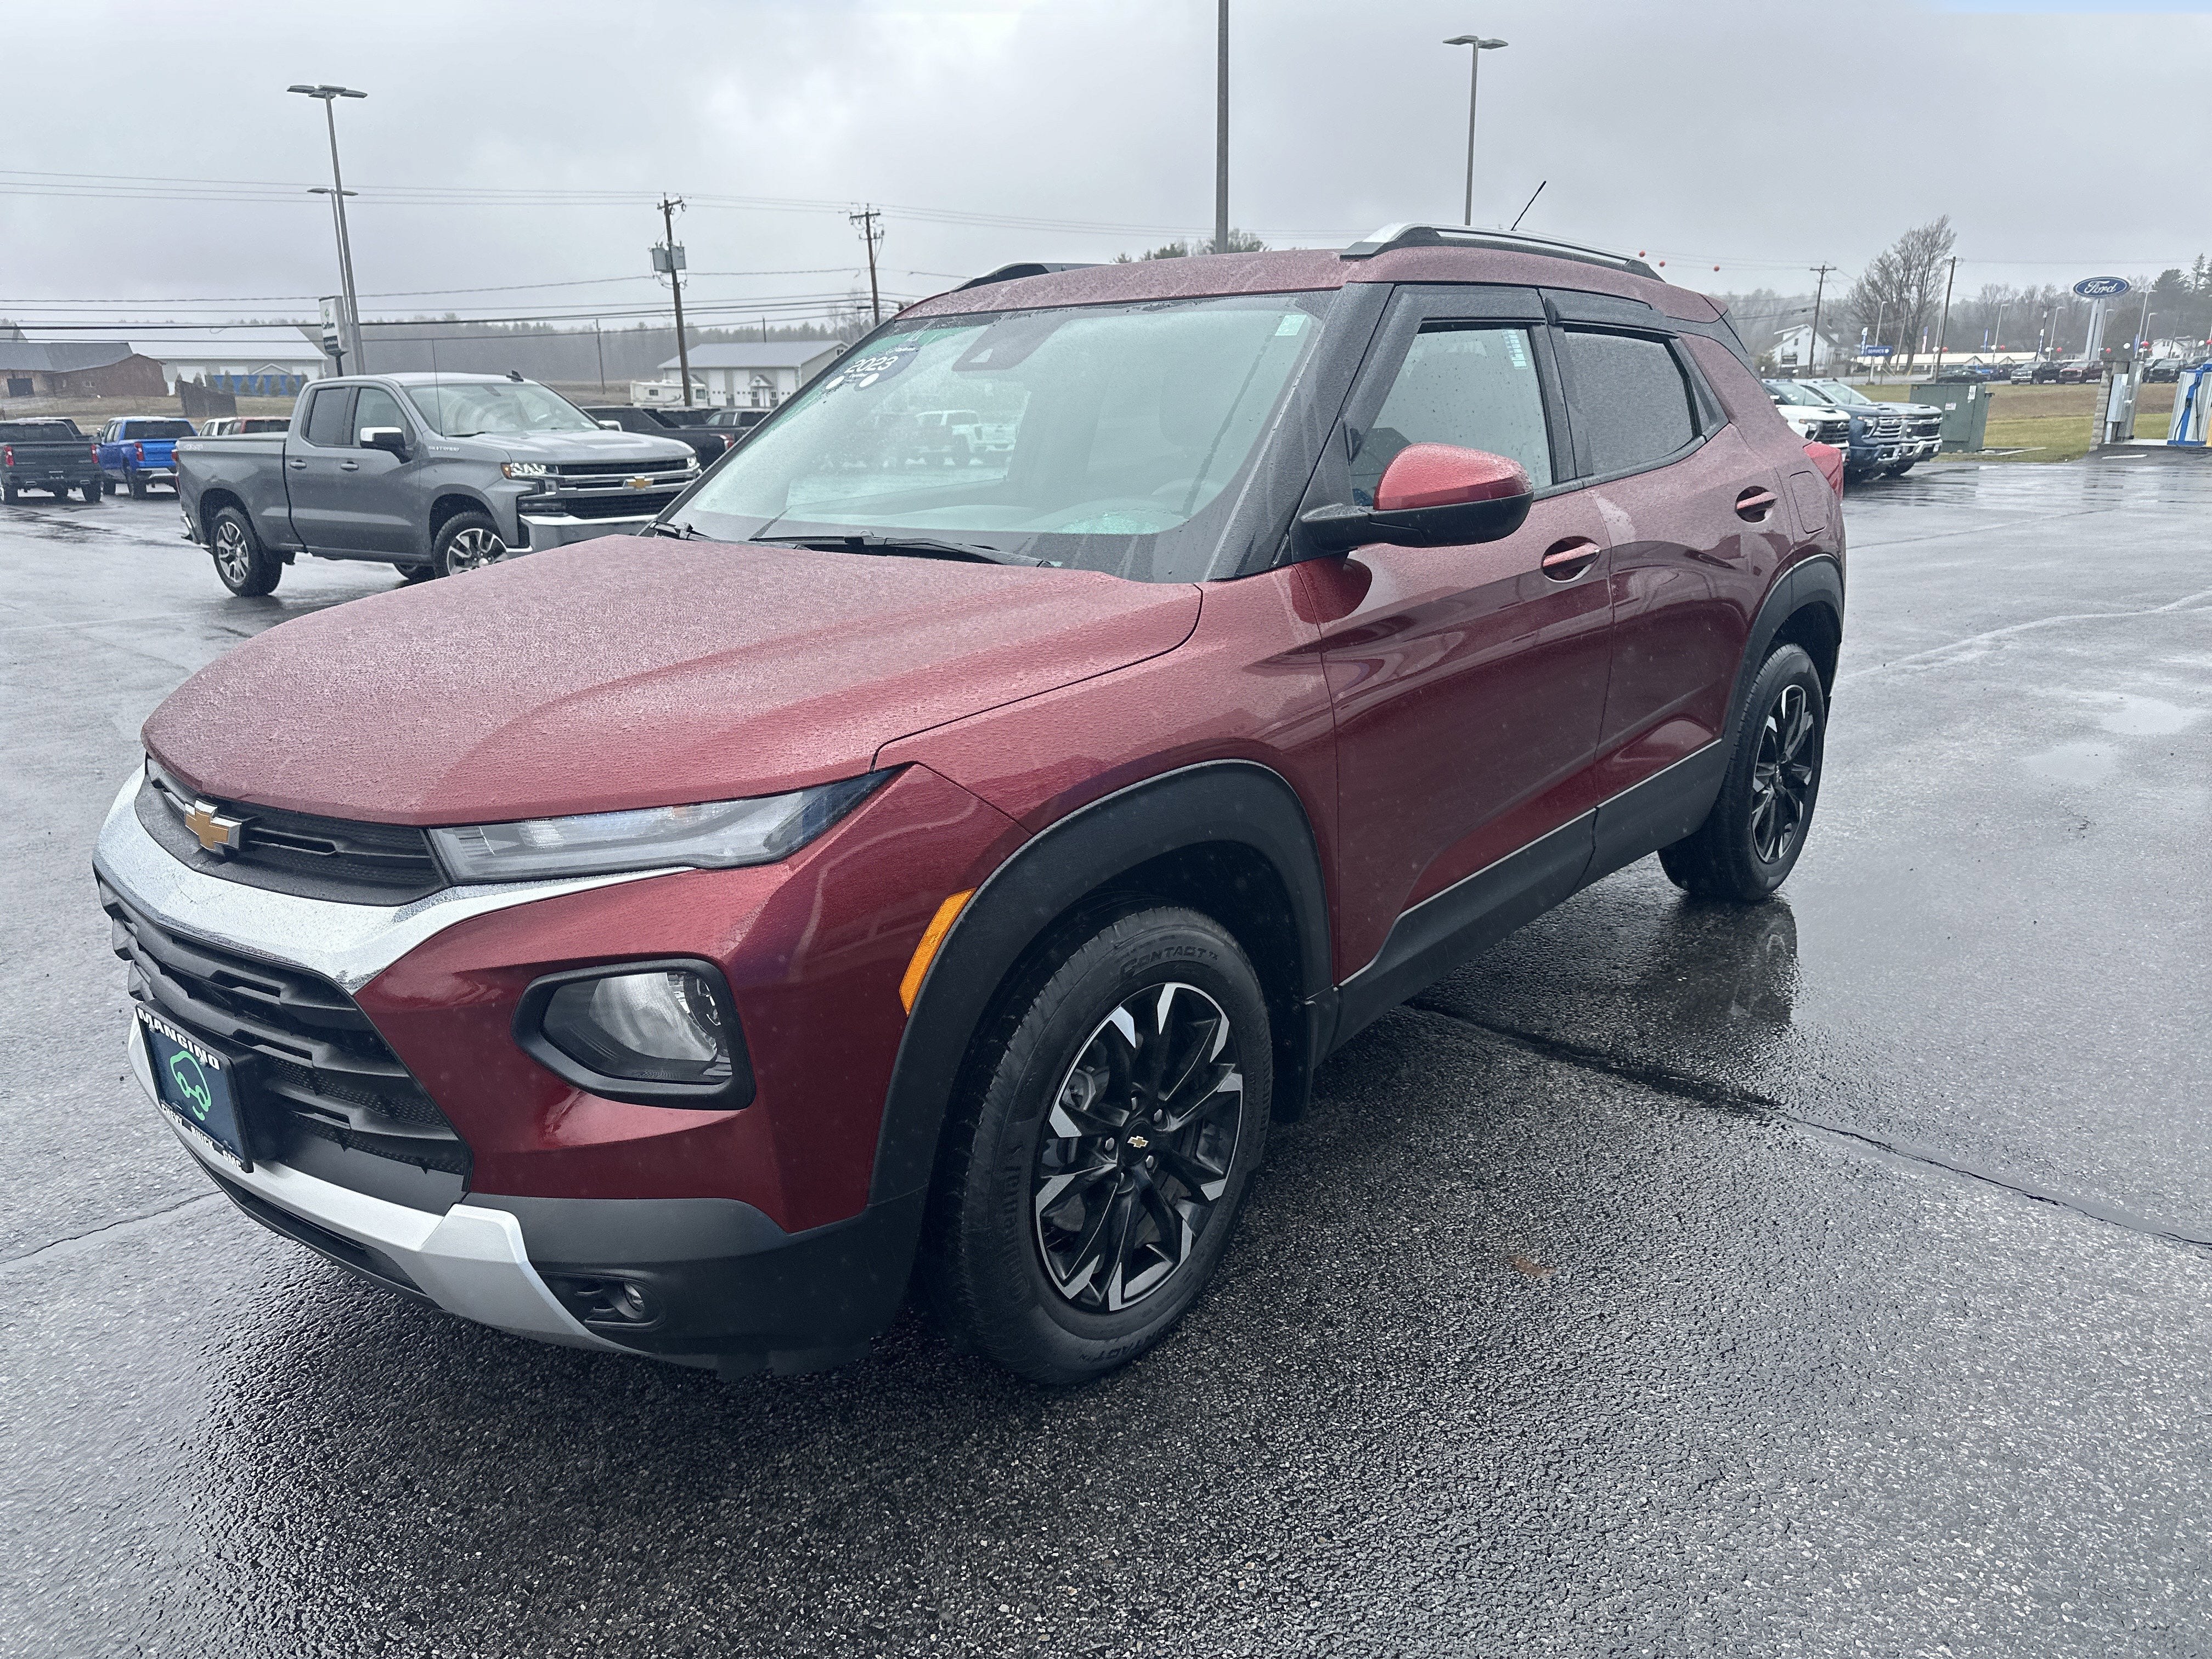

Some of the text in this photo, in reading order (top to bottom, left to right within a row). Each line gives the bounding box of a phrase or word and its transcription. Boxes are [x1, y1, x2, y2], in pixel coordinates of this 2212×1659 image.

[2084, 280, 2118, 294] Ford
[844, 356, 898, 373] 2023
[137, 1007, 220, 1070] MANGINO
[161, 1104, 242, 1171] CHEVY BUICK GMC
